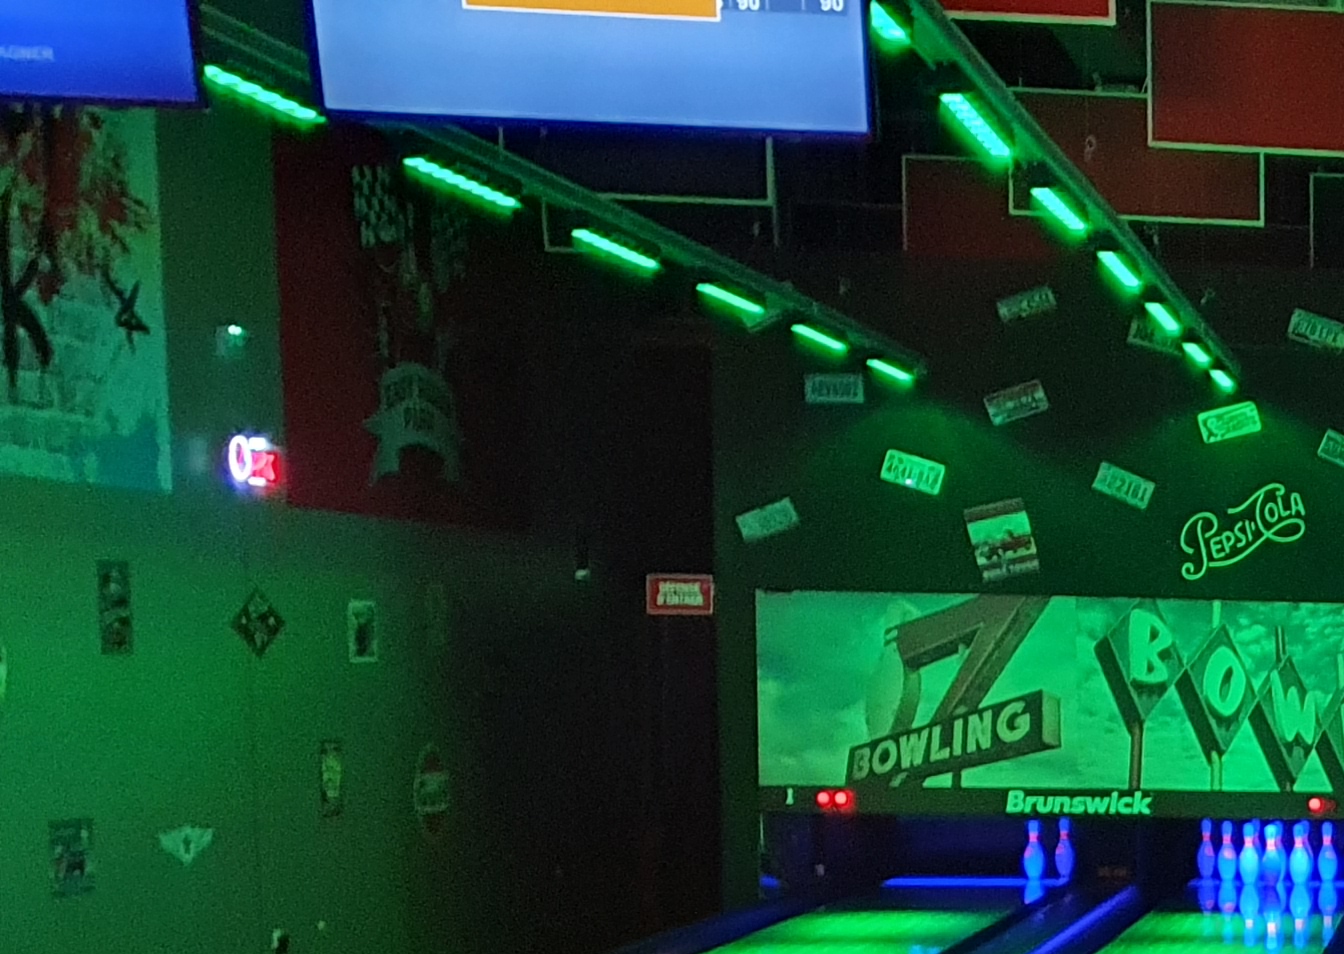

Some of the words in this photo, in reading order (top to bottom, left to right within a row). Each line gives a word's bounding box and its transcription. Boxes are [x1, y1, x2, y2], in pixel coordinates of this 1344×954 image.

[854, 702, 1032, 781] BOWLING
[785, 788, 795, 805] 1
[1005, 789, 1152, 816] Brunswick
